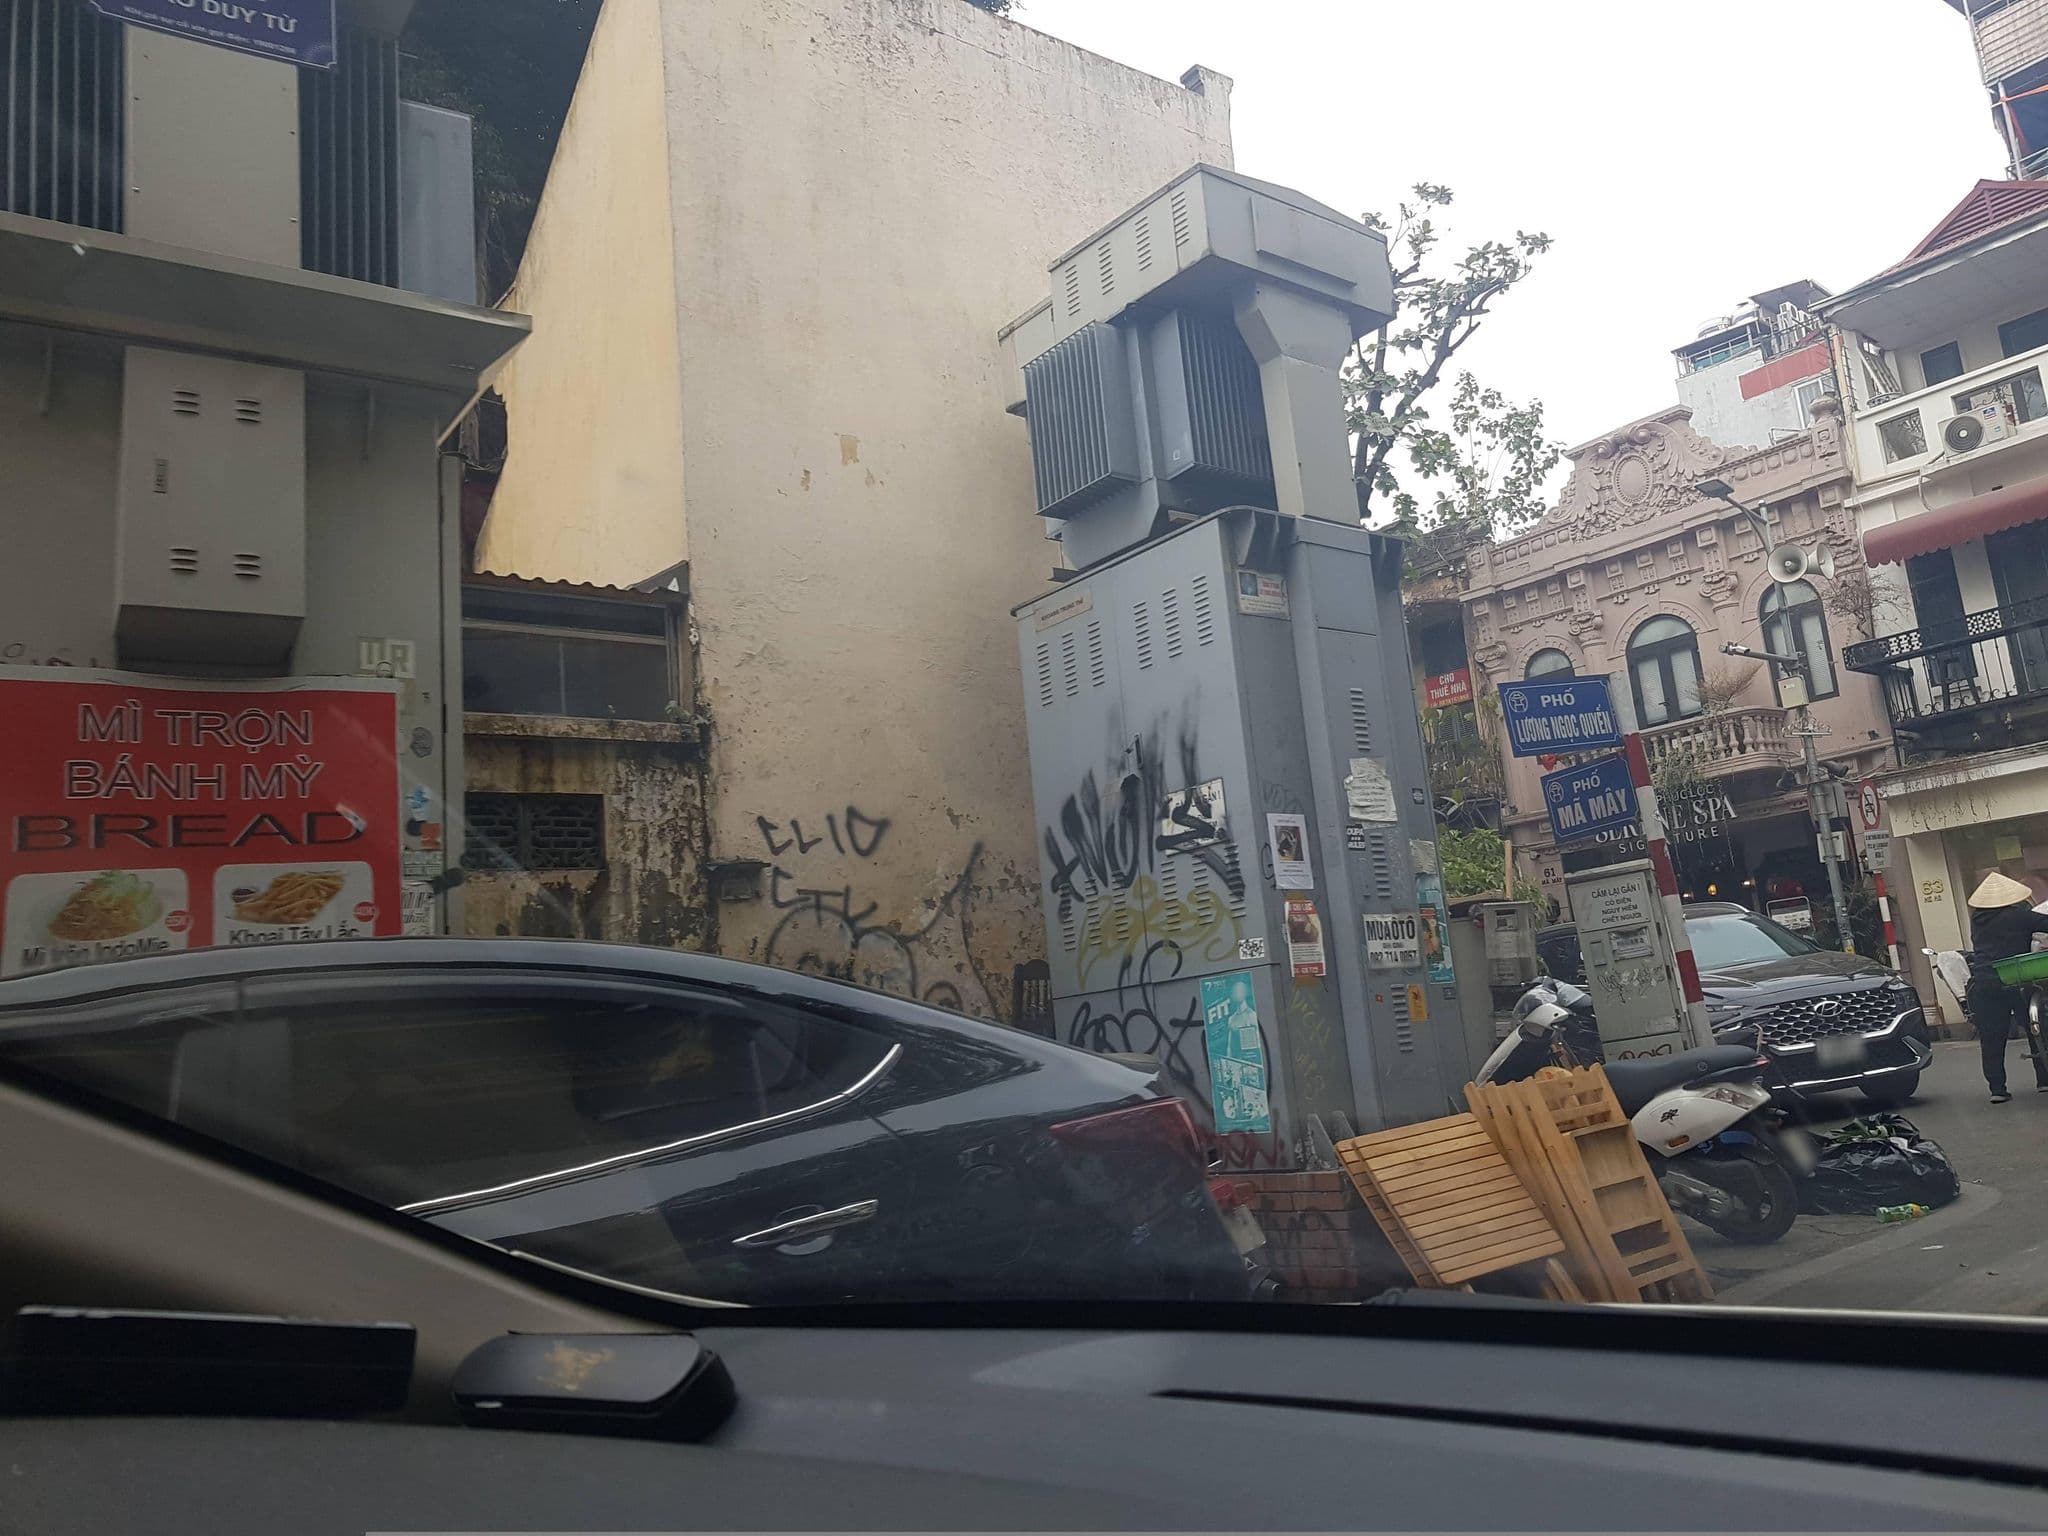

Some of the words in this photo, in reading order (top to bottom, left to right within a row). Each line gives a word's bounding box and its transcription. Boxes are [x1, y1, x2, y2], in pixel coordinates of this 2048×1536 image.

[202, 0, 256, 23] DUY
[261, 12, 298, 33] TỪ
[1430, 684, 1450, 700] THUÊ
[1450, 680, 1467, 695] NHÀ
[1439, 672, 1455, 685] CHO
[1540, 687, 1575, 707] PHỐ
[78, 698, 142, 744] MÌ
[154, 708, 313, 753] TRỘN
[1516, 715, 1552, 743] LƯƠNG
[1550, 713, 1580, 743] NGỌC
[64, 752, 225, 801] BÁNH
[240, 753, 325, 800] MỲ
[1572, 769, 1601, 793] PHỐ
[1557, 797, 1587, 829] MÃ
[1588, 787, 1627, 820] MÂY
[1692, 795, 1738, 825] SPA
[12, 811, 367, 853] BREAD
[1619, 826, 1720, 854] SIGTURE
[1543, 867, 1556, 878] 61
[1207, 998, 1230, 1025] FIT
